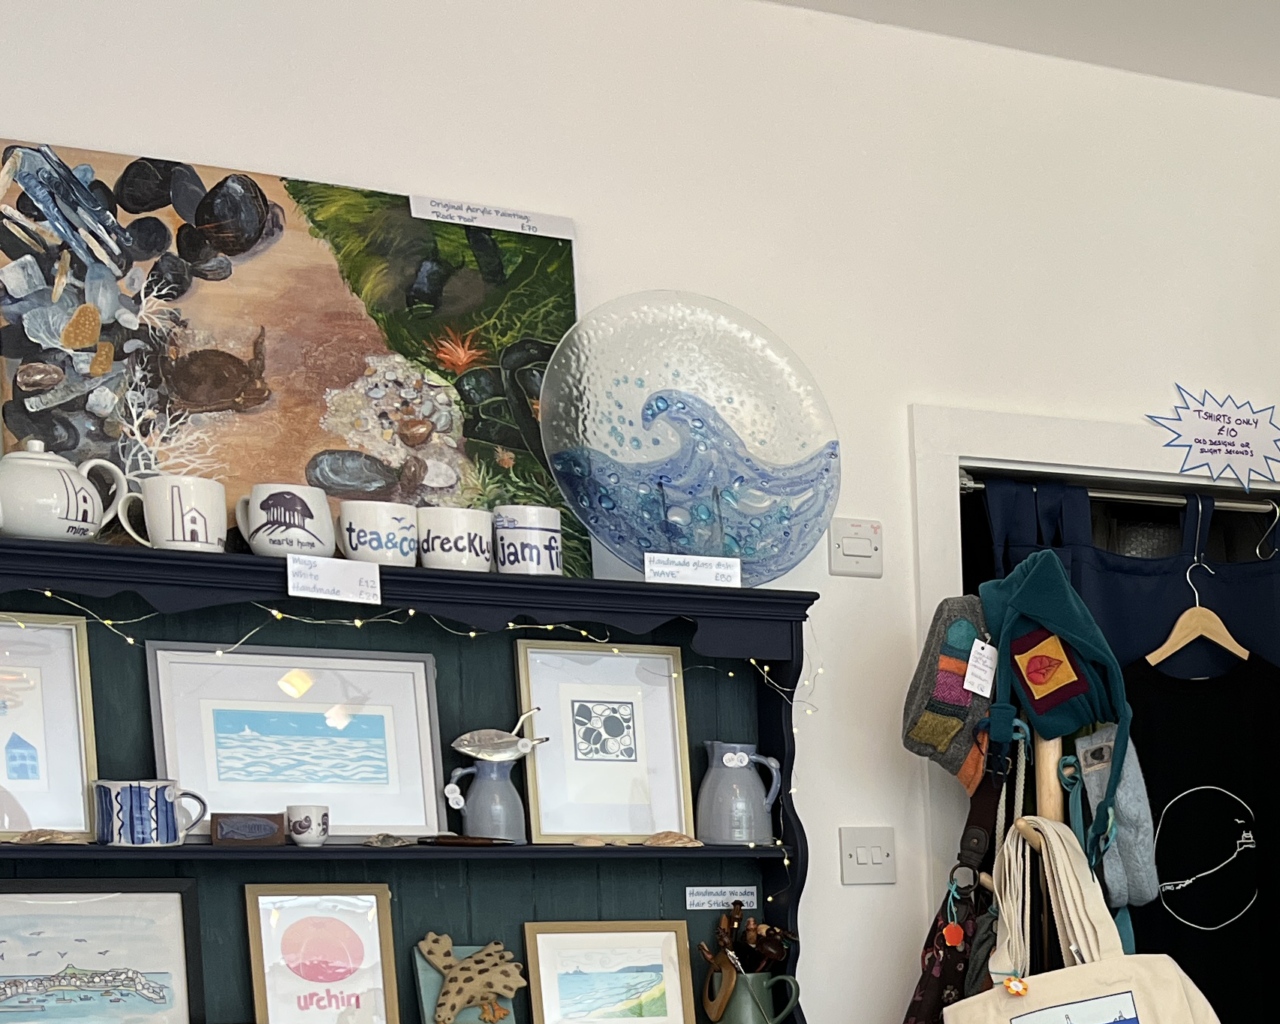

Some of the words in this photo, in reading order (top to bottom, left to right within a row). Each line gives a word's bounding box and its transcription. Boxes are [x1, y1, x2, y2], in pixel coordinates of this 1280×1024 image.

[430, 200, 463, 212] Original
[465, 205, 492, 216] Acrylic
[521, 223, 538, 232] £70
[1193, 409, 1232, 425] TSHIRTS
[1234, 418, 1259, 429] ONLY
[1217, 425, 1238, 438] £10
[1209, 439, 1236, 448] DESIGNS
[66, 524, 90, 537] mine
[269, 537, 294, 548] nearly
[296, 539, 316, 549] home
[346, 521, 418, 557] tea&co
[421, 529, 491, 562] dreckly
[499, 536, 541, 567] jam
[292, 556, 318, 568] Mugs
[649, 557, 691, 569] Handmade
[693, 559, 713, 571] glass
[292, 570, 319, 582] White
[650, 570, 681, 579] "WAVE"
[715, 573, 732, 583] £80
[292, 582, 341, 597] Handmade
[688, 889, 727, 898] Handmade
[708, 900, 730, 908] Sticks
[296, 988, 361, 1011] urchin
